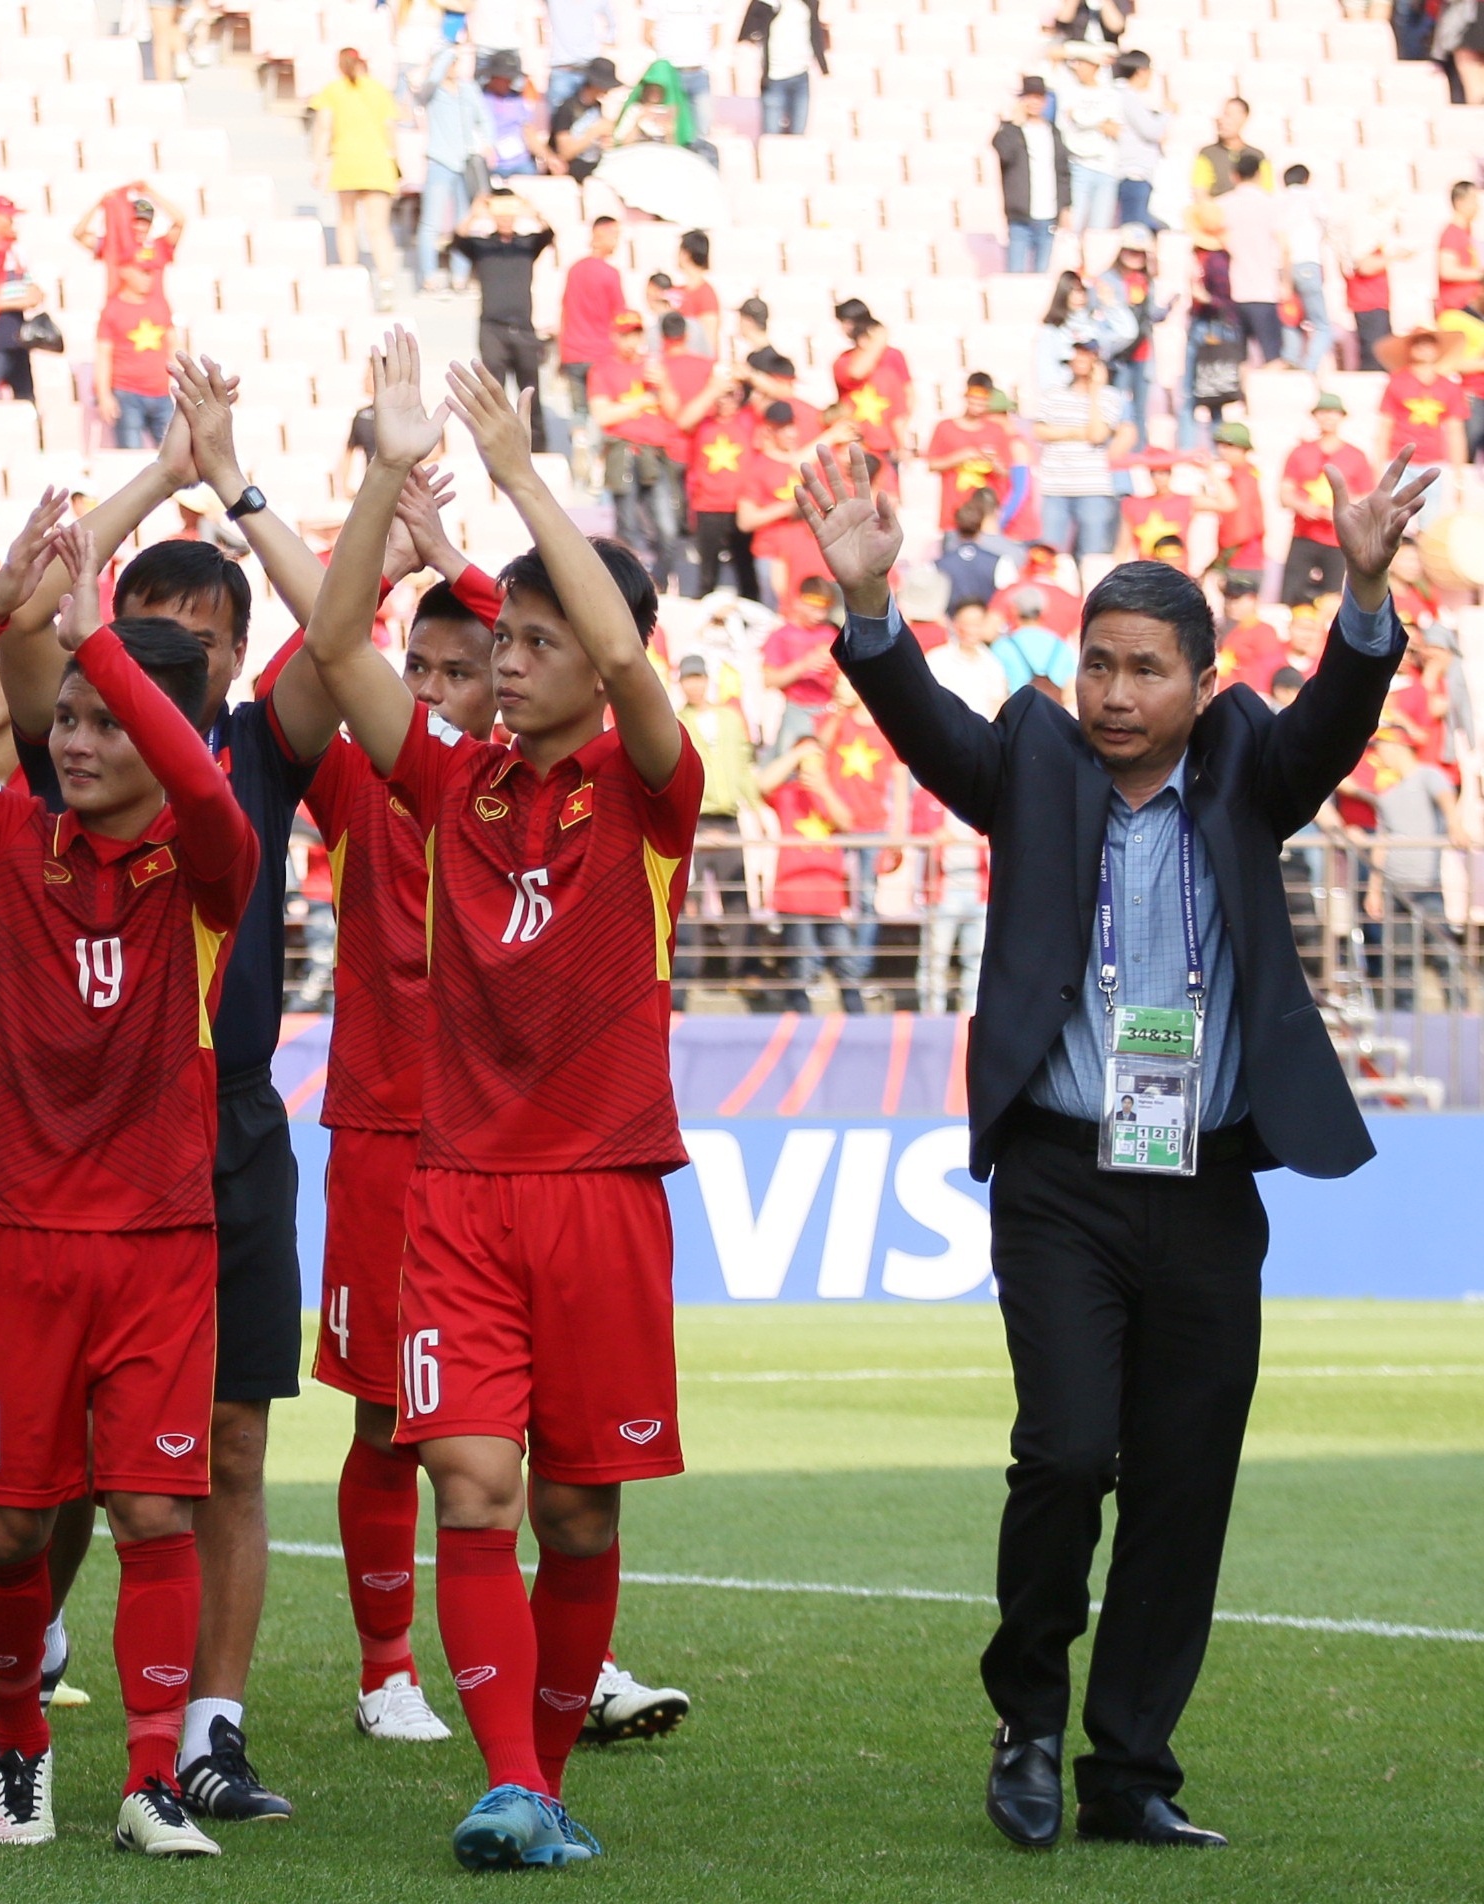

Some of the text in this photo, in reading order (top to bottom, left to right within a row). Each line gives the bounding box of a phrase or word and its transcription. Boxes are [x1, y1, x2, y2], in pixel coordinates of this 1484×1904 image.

[501, 868, 553, 944] 16
[1186, 921, 1195, 949] REPUBLIC
[74, 936, 123, 1008] 19
[1190, 950, 1198, 966] 2017
[1127, 1027, 1182, 1043] 34&35
[1138, 1141, 1176, 1151] 4 6
[1140, 1129, 1146, 1137] 1
[1154, 1129, 1162, 1138] 2
[1169, 1130, 1177, 1139] 3
[1138, 1153, 1145, 1161] 7
[680, 1125, 1000, 1301] VIS
[329, 1286, 350, 1359] 4
[403, 1329, 440, 1419] 16
